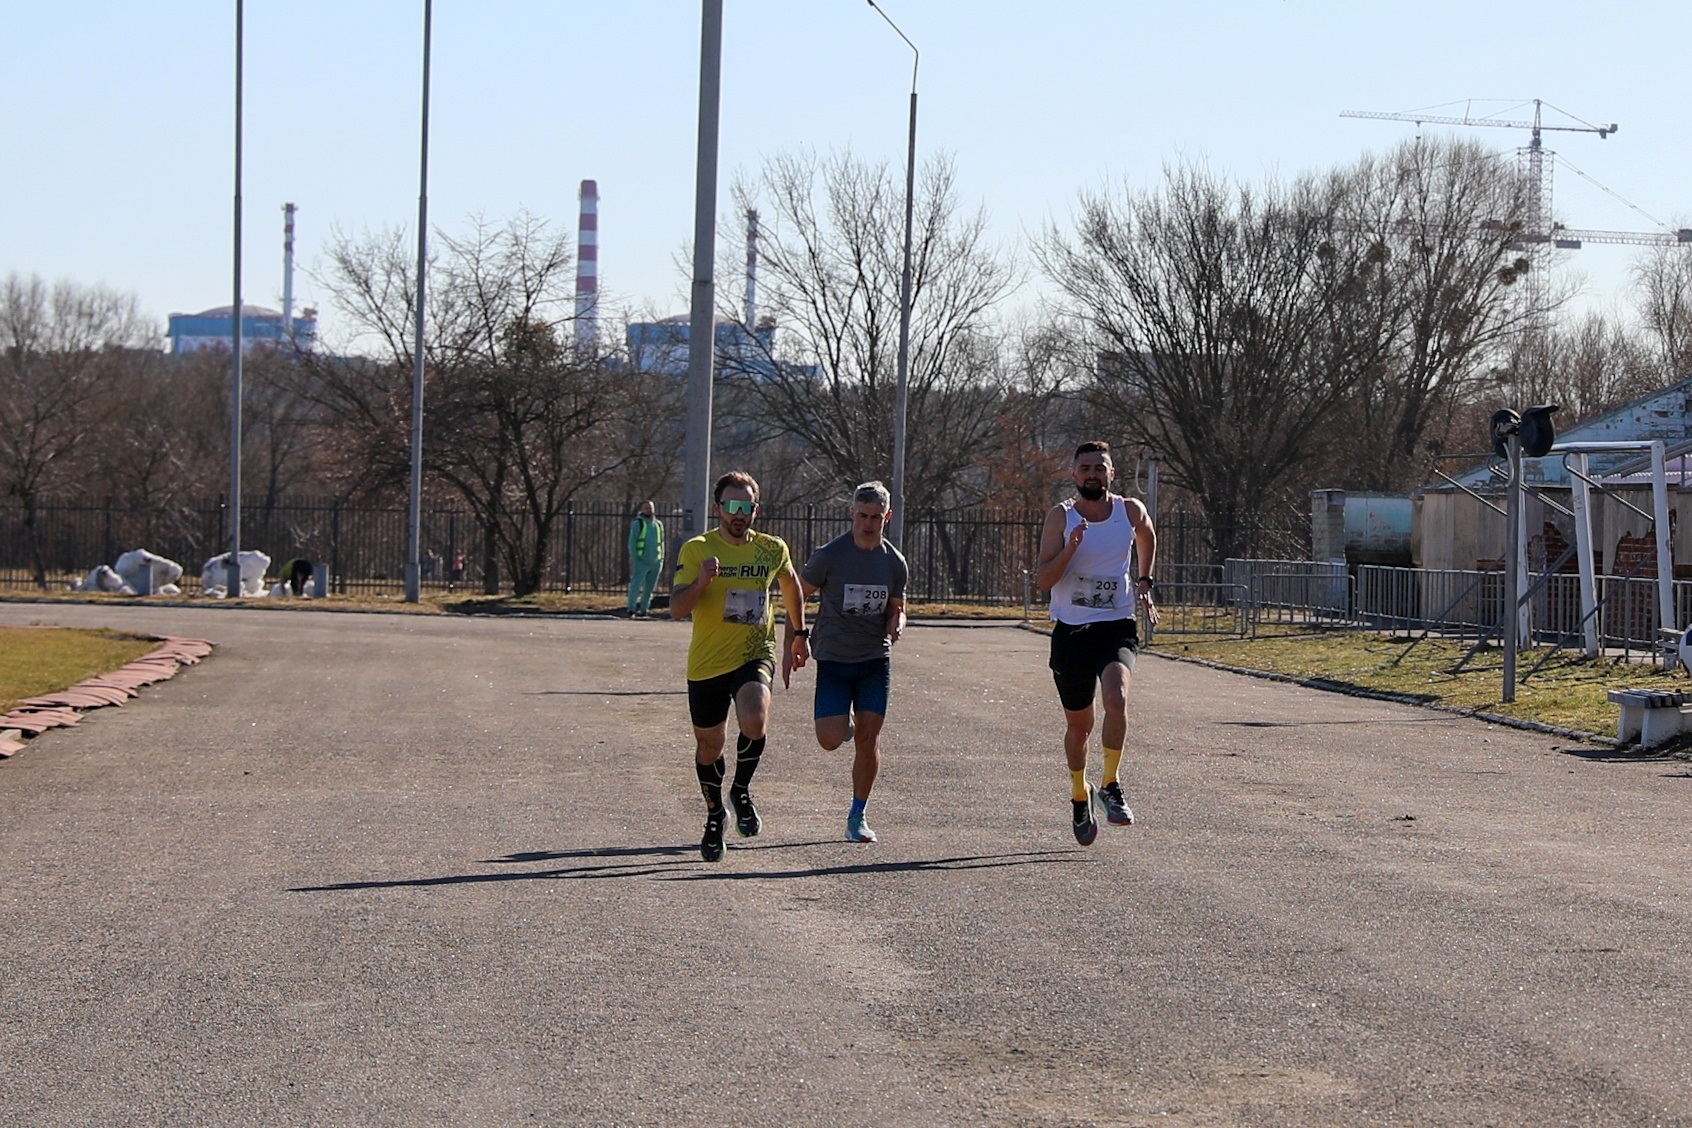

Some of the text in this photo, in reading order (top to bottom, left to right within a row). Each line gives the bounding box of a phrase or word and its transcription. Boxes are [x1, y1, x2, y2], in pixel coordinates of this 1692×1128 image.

[740, 565, 769, 578] RUN
[1096, 581, 1118, 591] 203
[865, 590, 887, 599] 208
